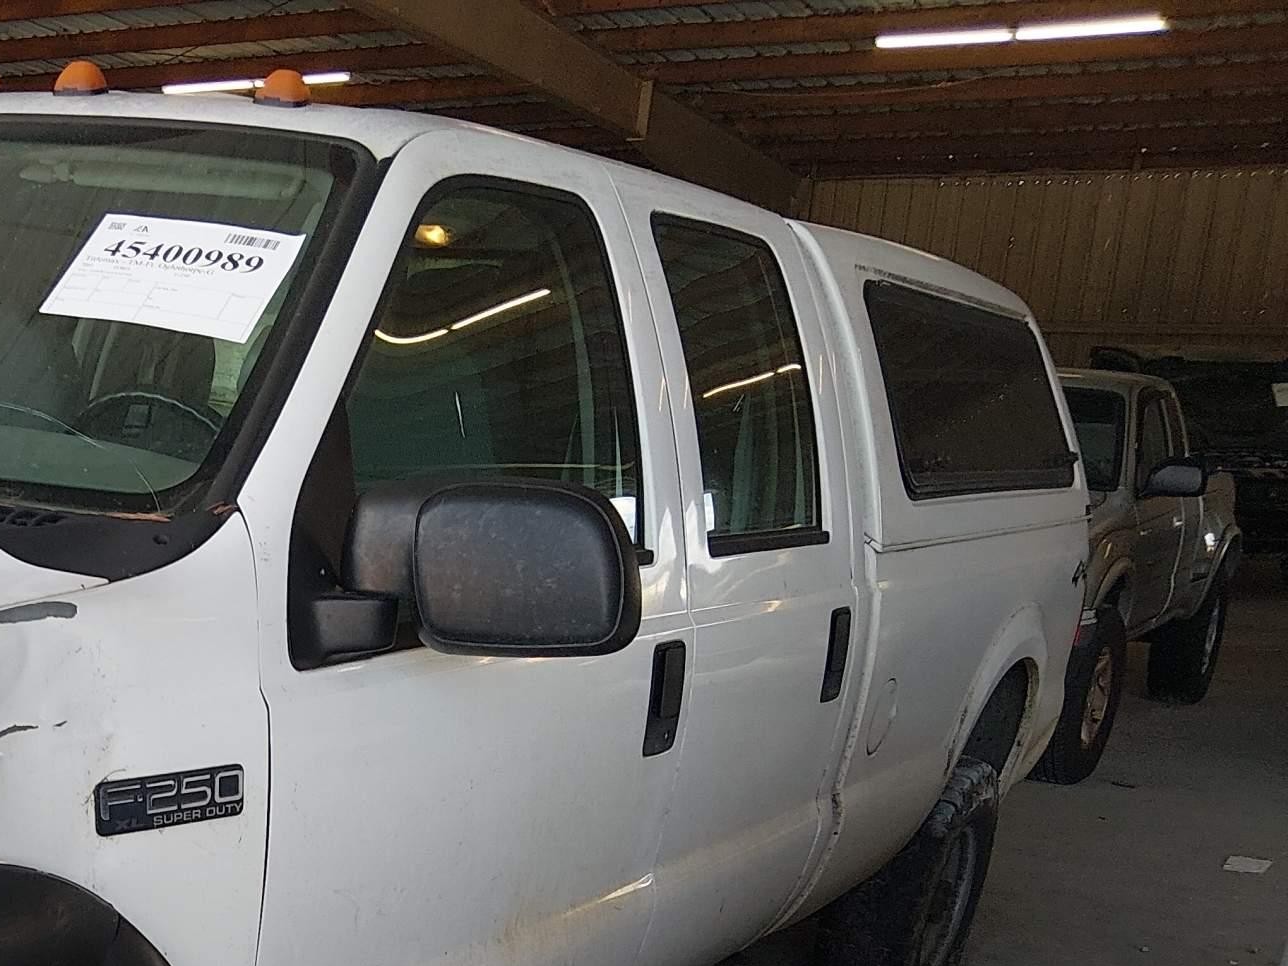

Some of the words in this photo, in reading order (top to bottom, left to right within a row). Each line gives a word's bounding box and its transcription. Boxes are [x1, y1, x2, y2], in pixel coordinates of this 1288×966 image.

[104, 239, 264, 274] 45400989
[100, 769, 243, 821] F-250
[153, 809, 201, 826] SUPER
[206, 802, 242, 817] DUTY
